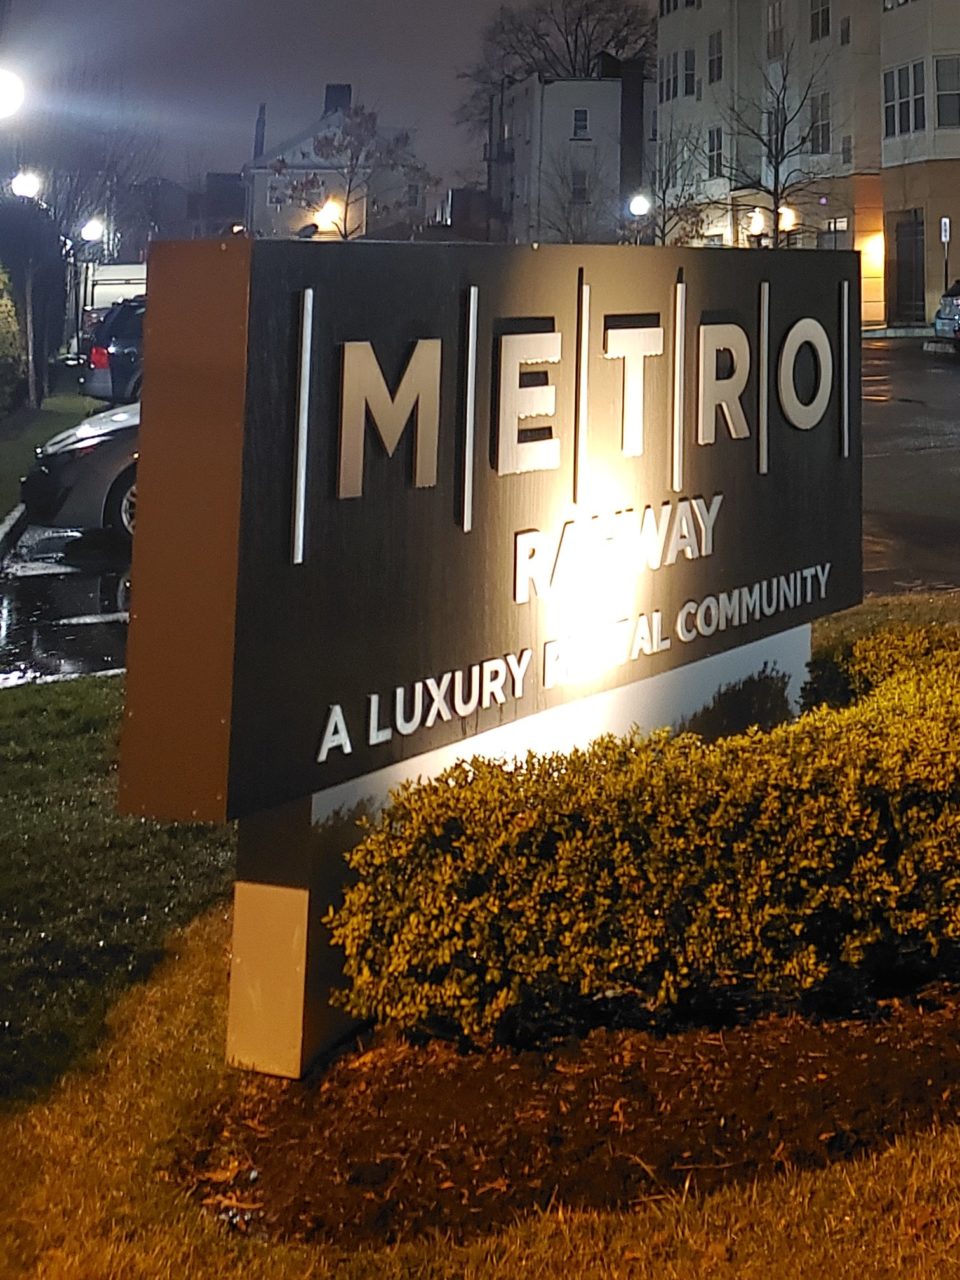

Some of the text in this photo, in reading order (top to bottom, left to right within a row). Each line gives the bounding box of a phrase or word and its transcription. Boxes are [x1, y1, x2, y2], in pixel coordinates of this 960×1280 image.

[337, 317, 833, 500] METRO
[513, 494, 724, 605] RAWAY
[316, 563, 832, 763] A LUXURY RAL COMMUNITY
